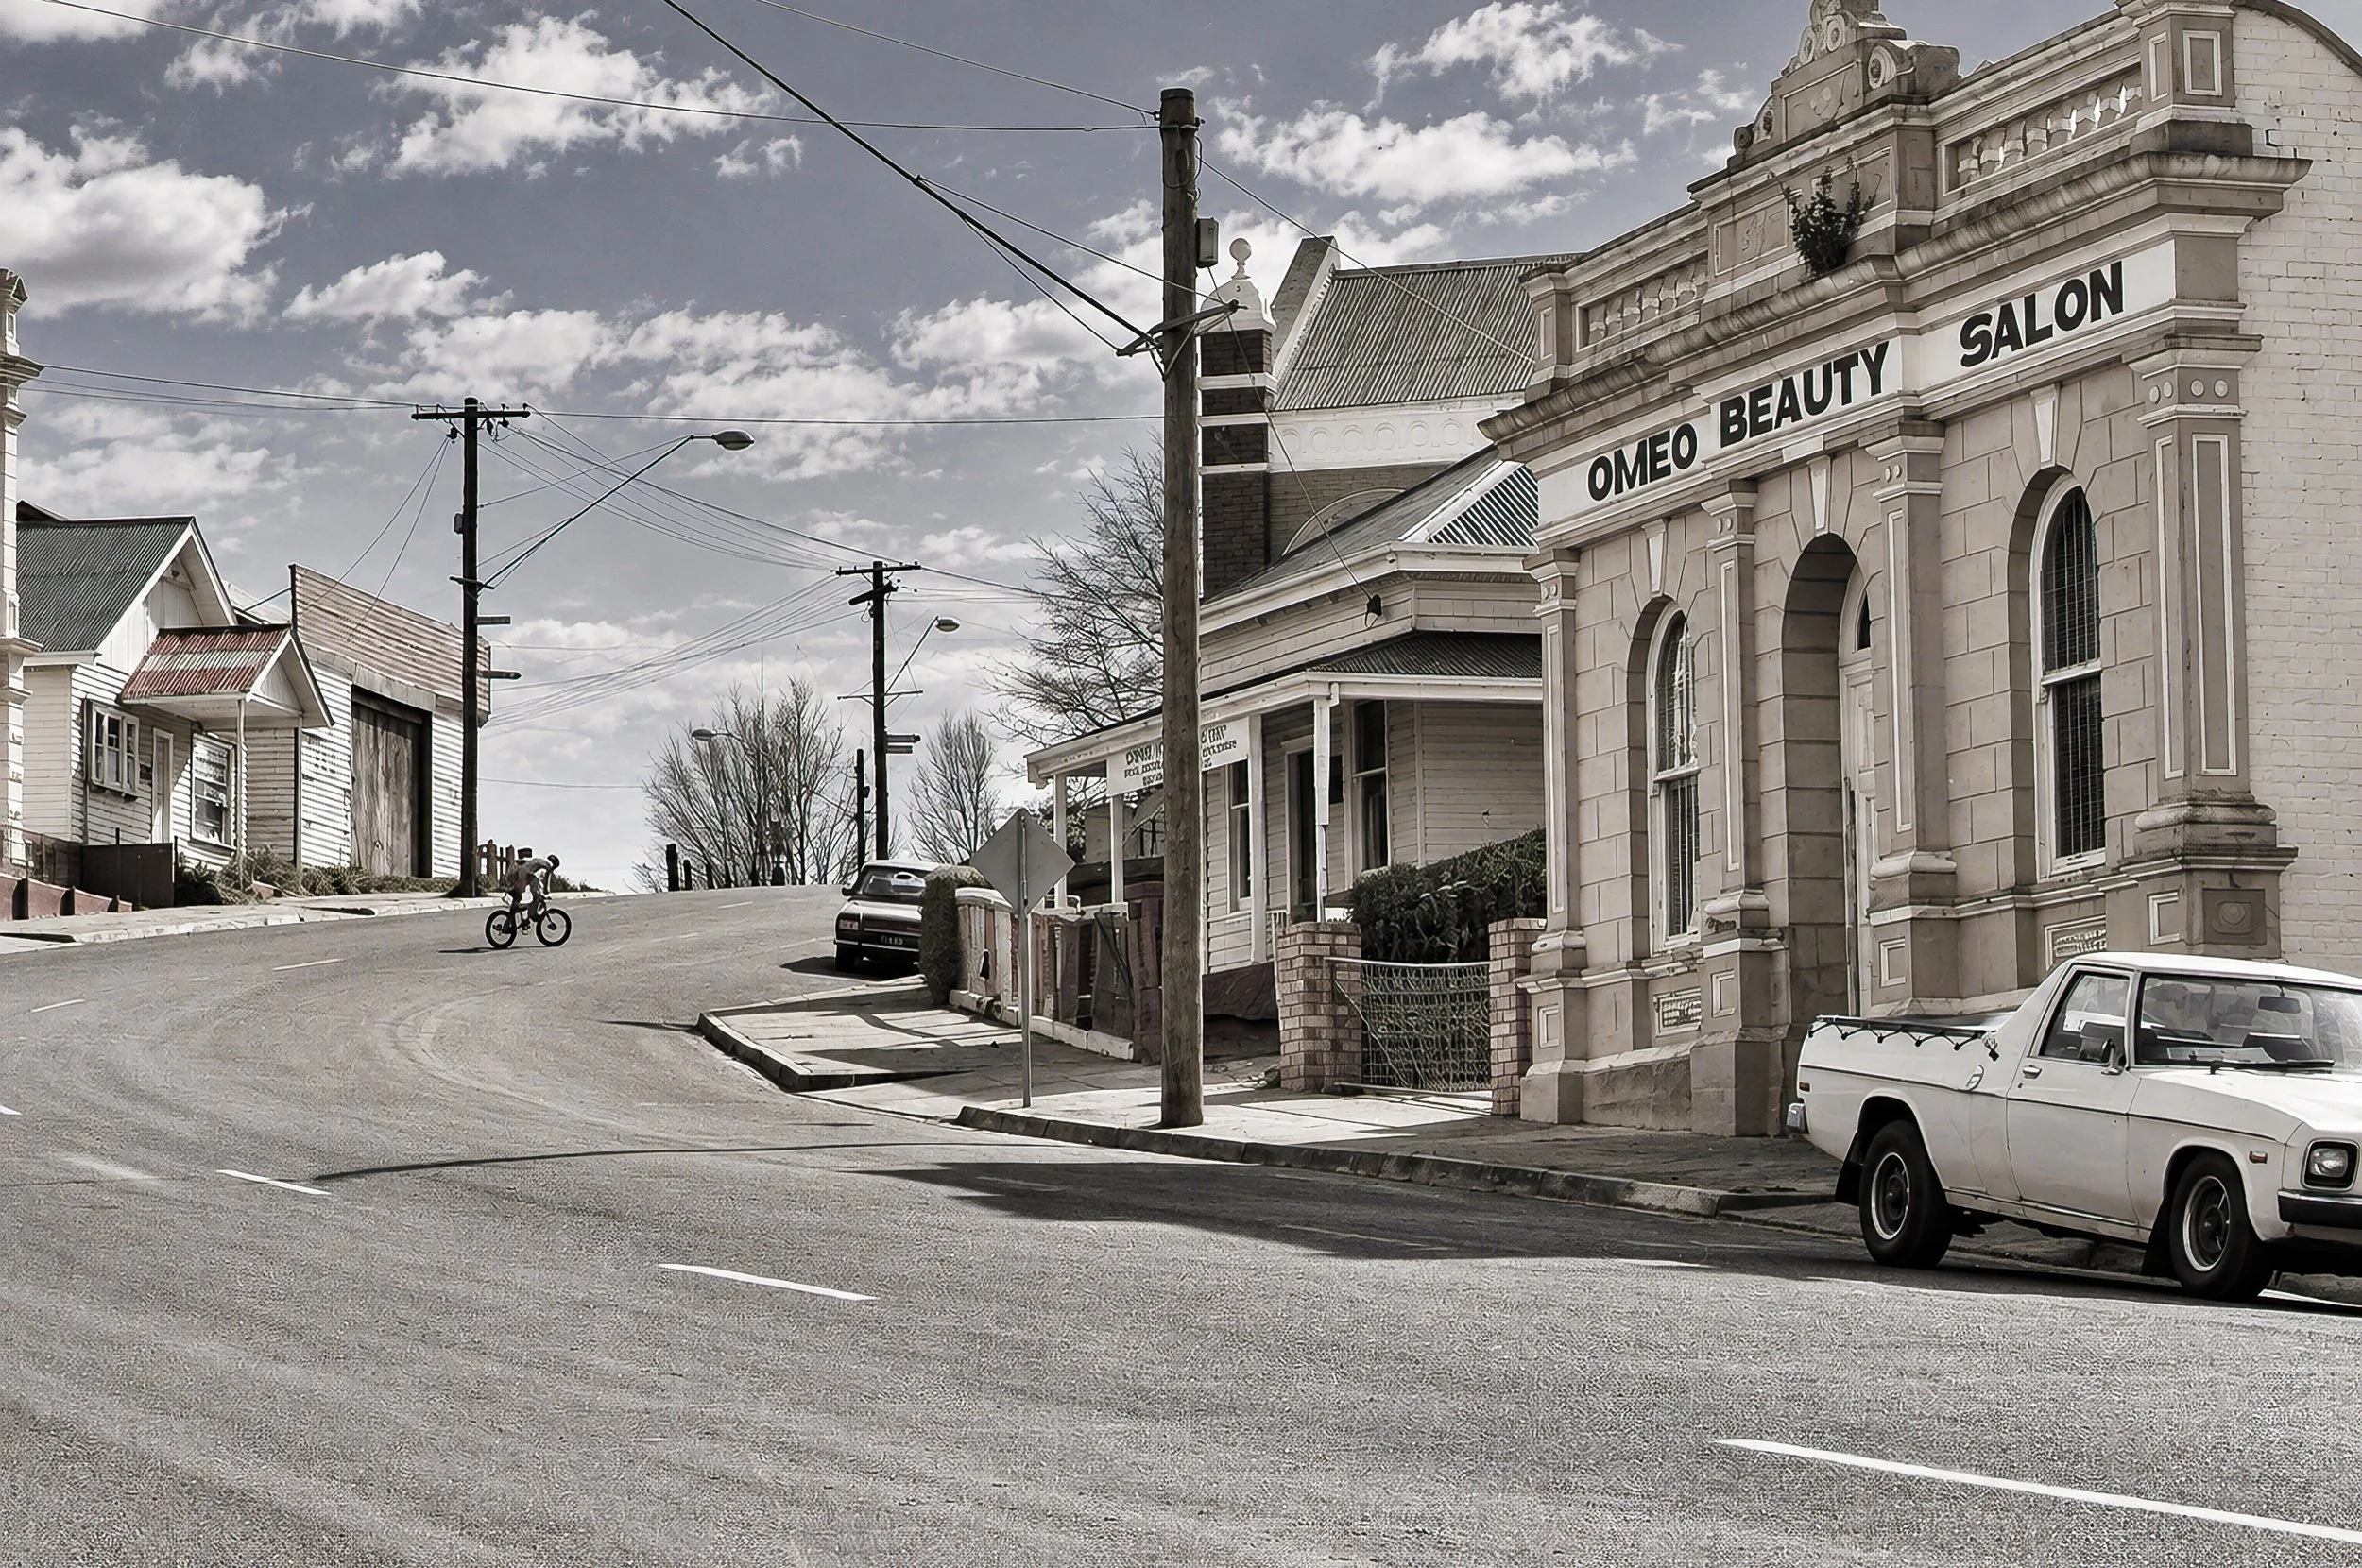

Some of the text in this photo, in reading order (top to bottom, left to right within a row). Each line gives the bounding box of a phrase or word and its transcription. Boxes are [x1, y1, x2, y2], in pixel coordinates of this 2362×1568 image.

[1587, 260, 2124, 502] OMEO BEAUTY SALON
